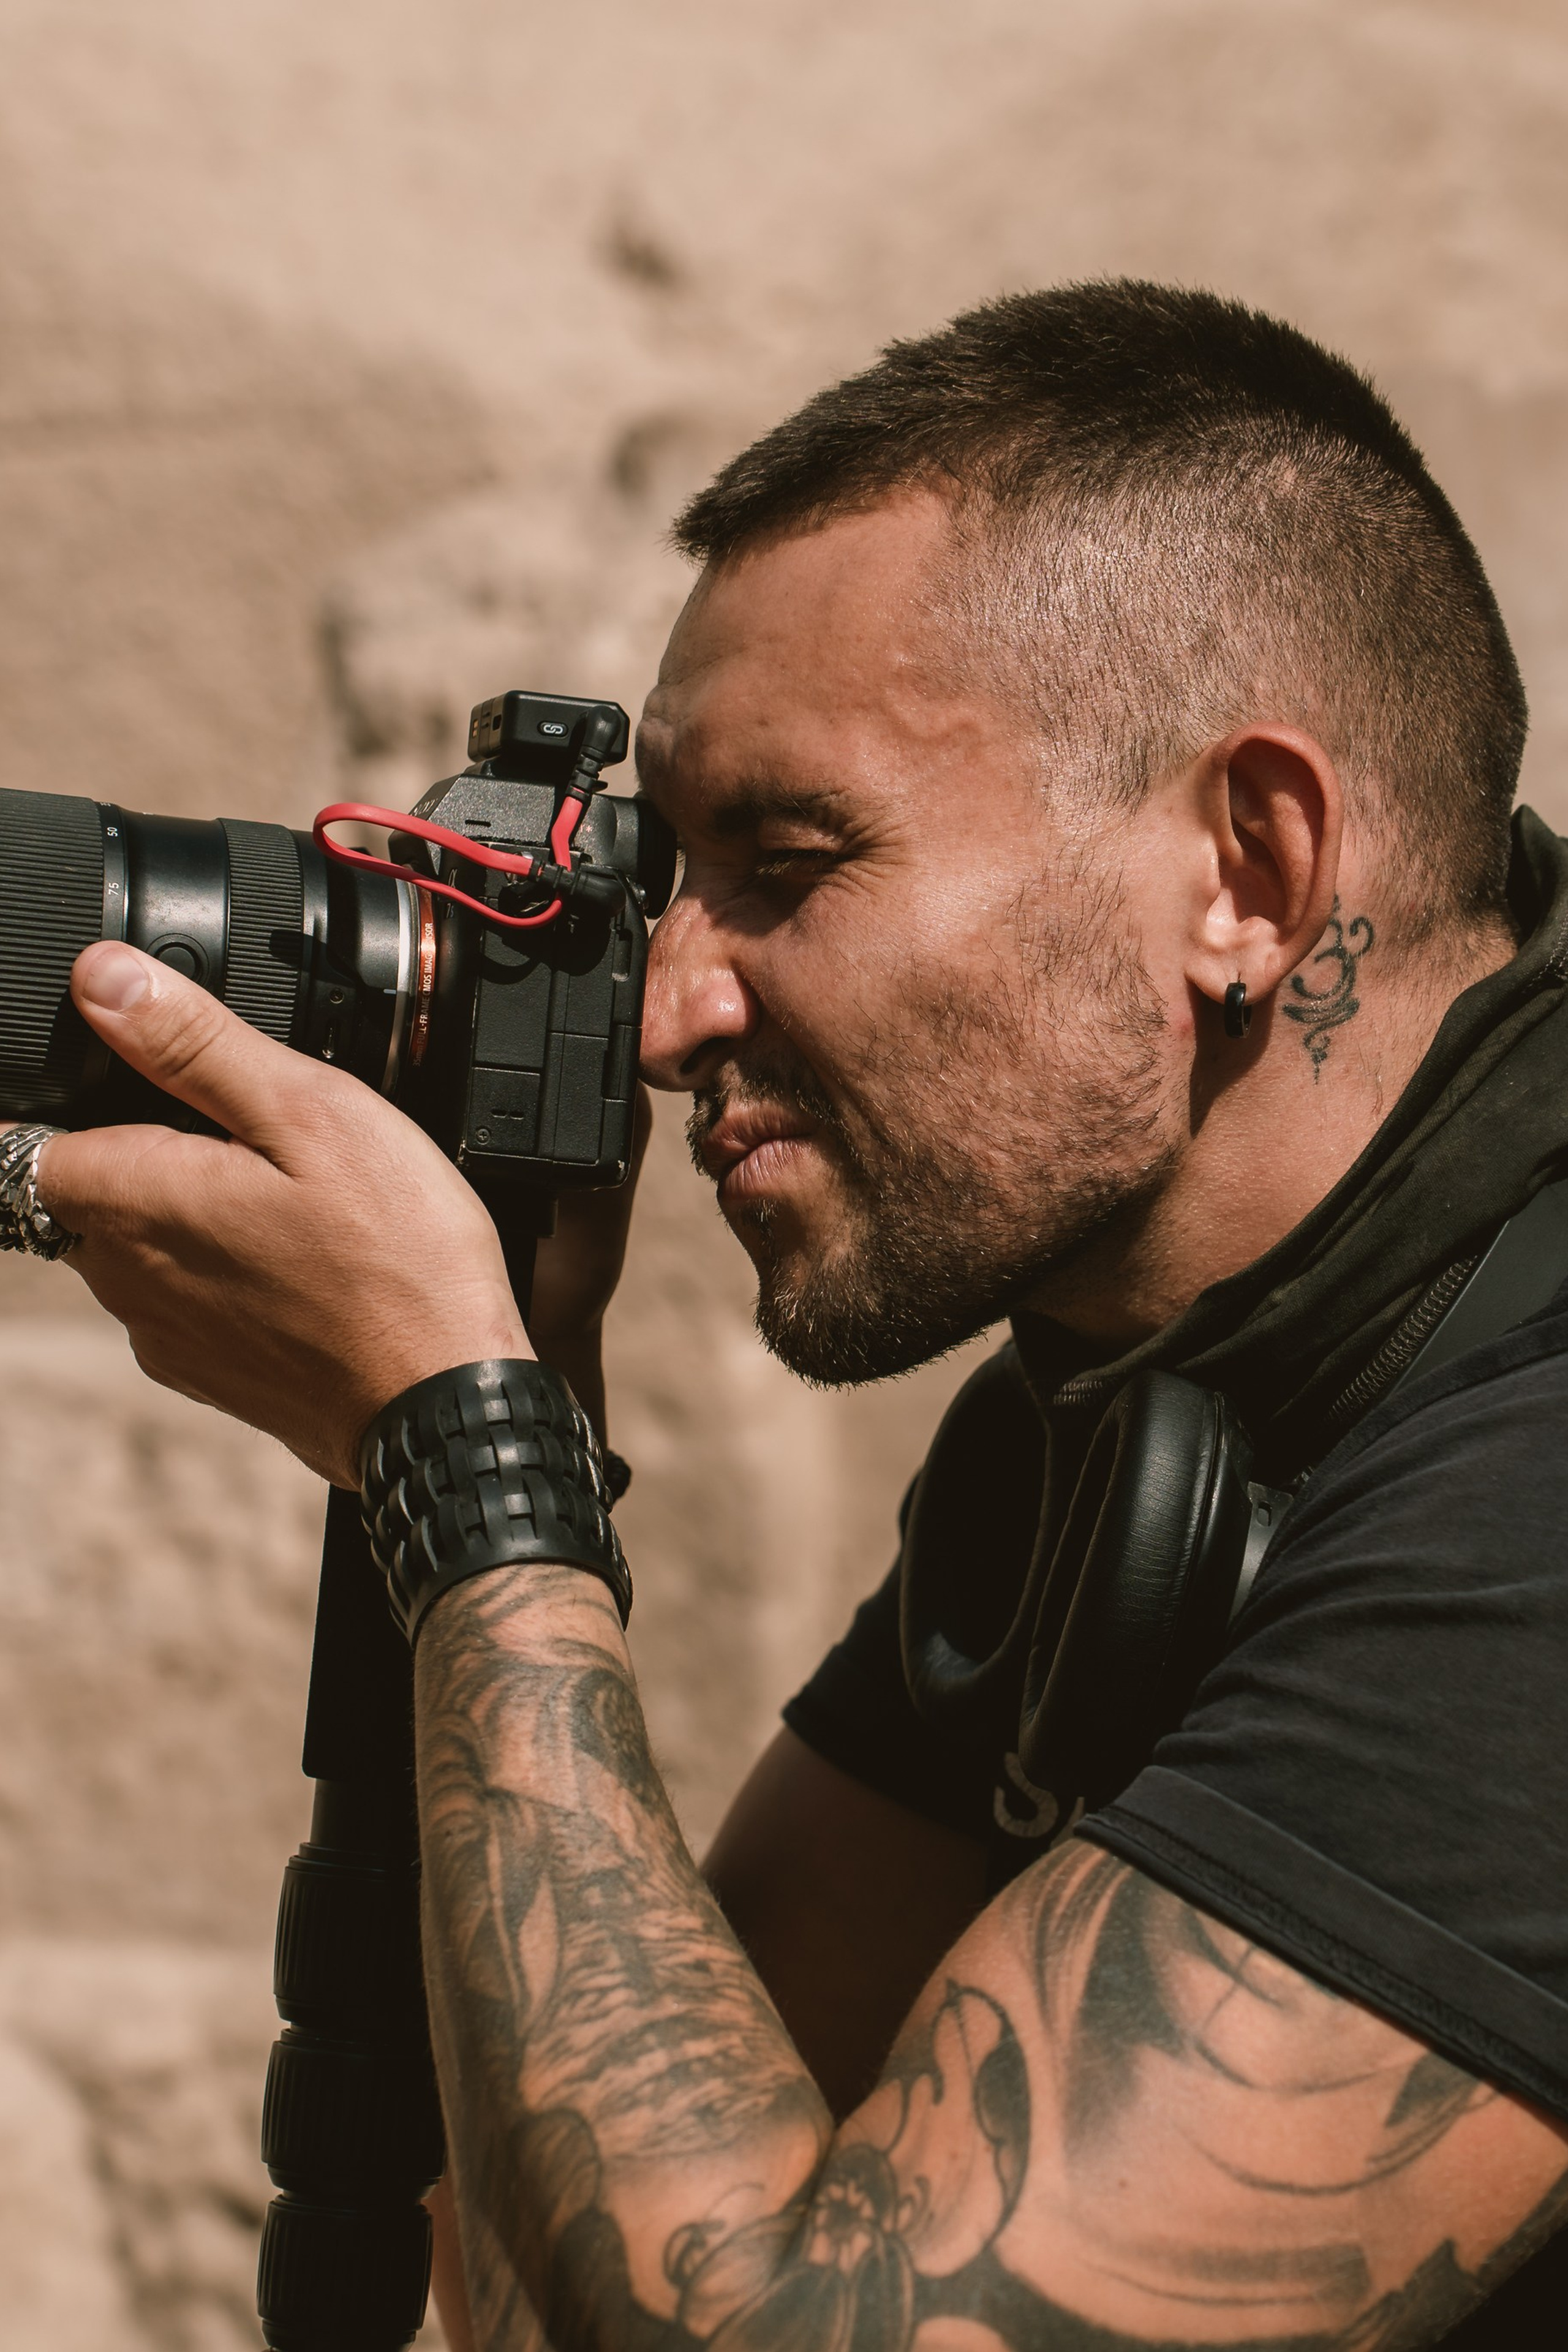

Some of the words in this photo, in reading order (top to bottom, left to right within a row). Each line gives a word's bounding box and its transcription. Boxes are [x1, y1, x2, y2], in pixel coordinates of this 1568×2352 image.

[107, 826, 118, 837] 50
[108, 882, 119, 896] 75
[424, 951, 433, 973] IMAG
[423, 974, 432, 996] CMOS
[417, 996, 430, 1045] FULL-FRAME
